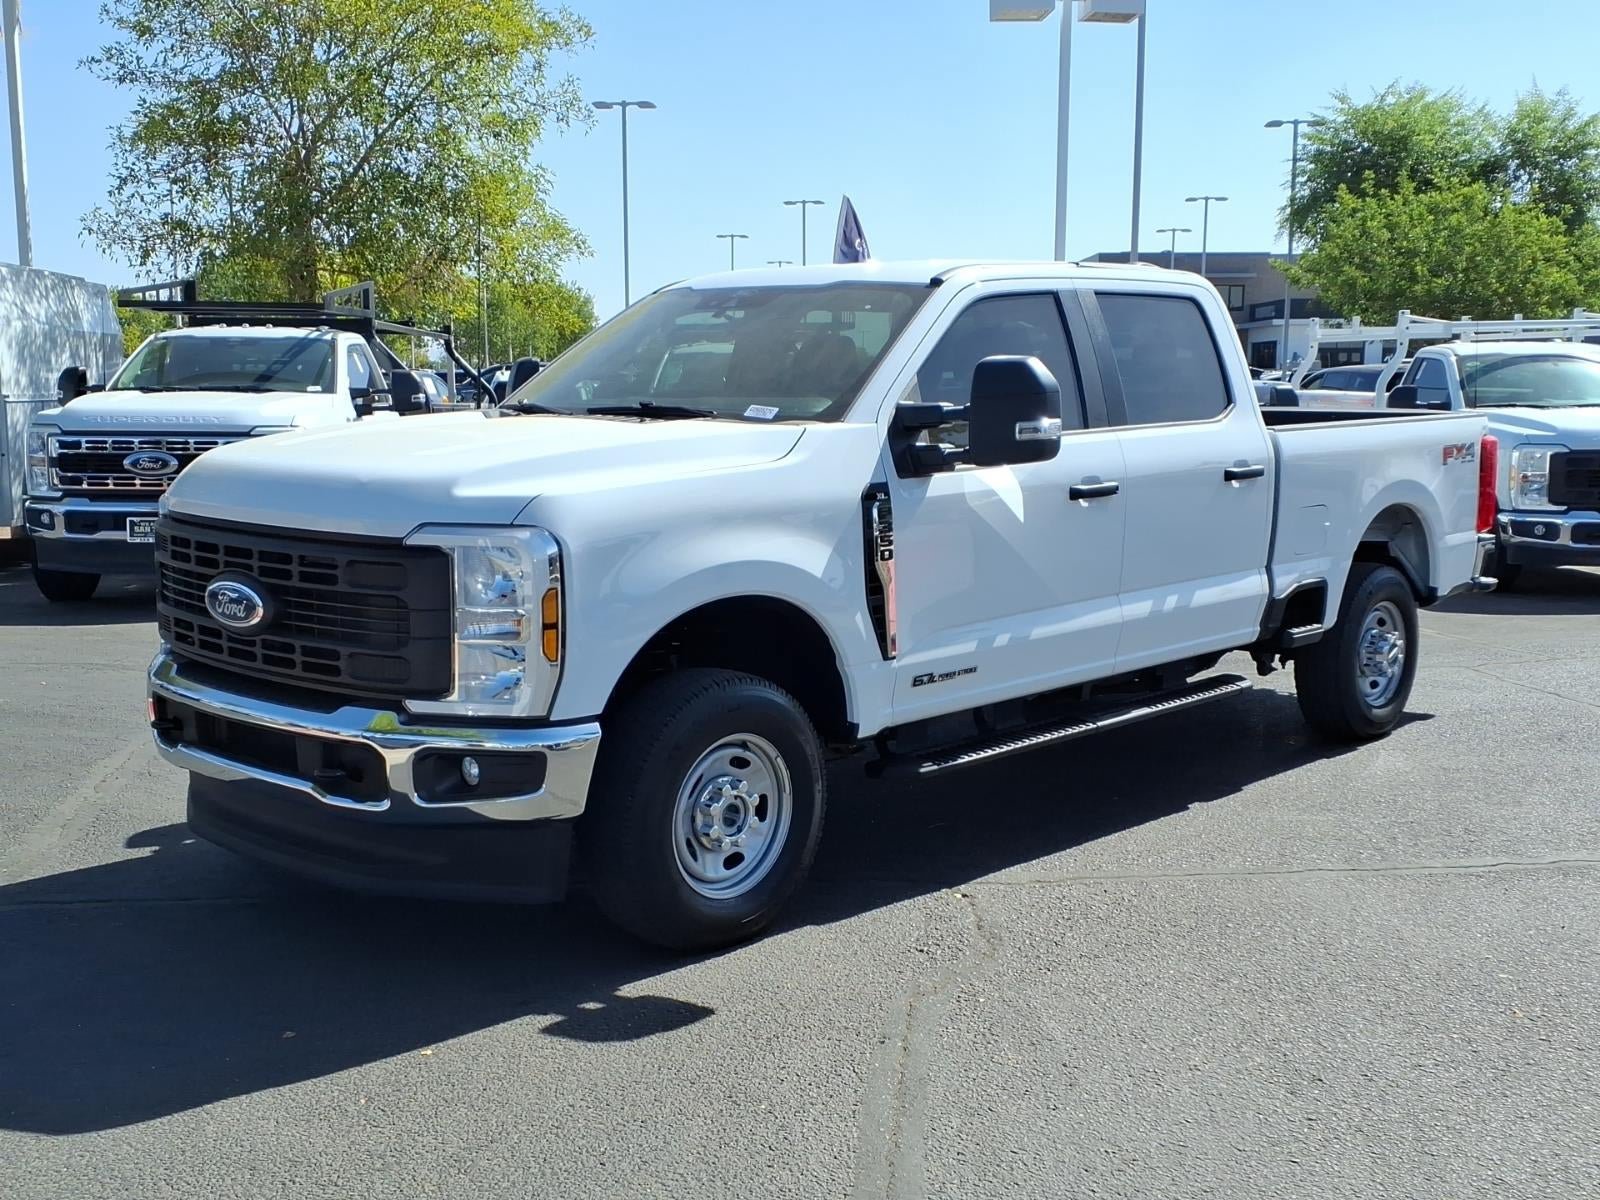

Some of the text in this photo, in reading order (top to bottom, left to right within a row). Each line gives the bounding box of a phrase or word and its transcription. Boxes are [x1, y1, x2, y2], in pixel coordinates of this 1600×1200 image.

[83, 415, 225, 424] SUPER DUTY
[1442, 443, 1475, 465] FX4
[137, 457, 162, 469] Ford
[215, 590, 246, 617] Ford
